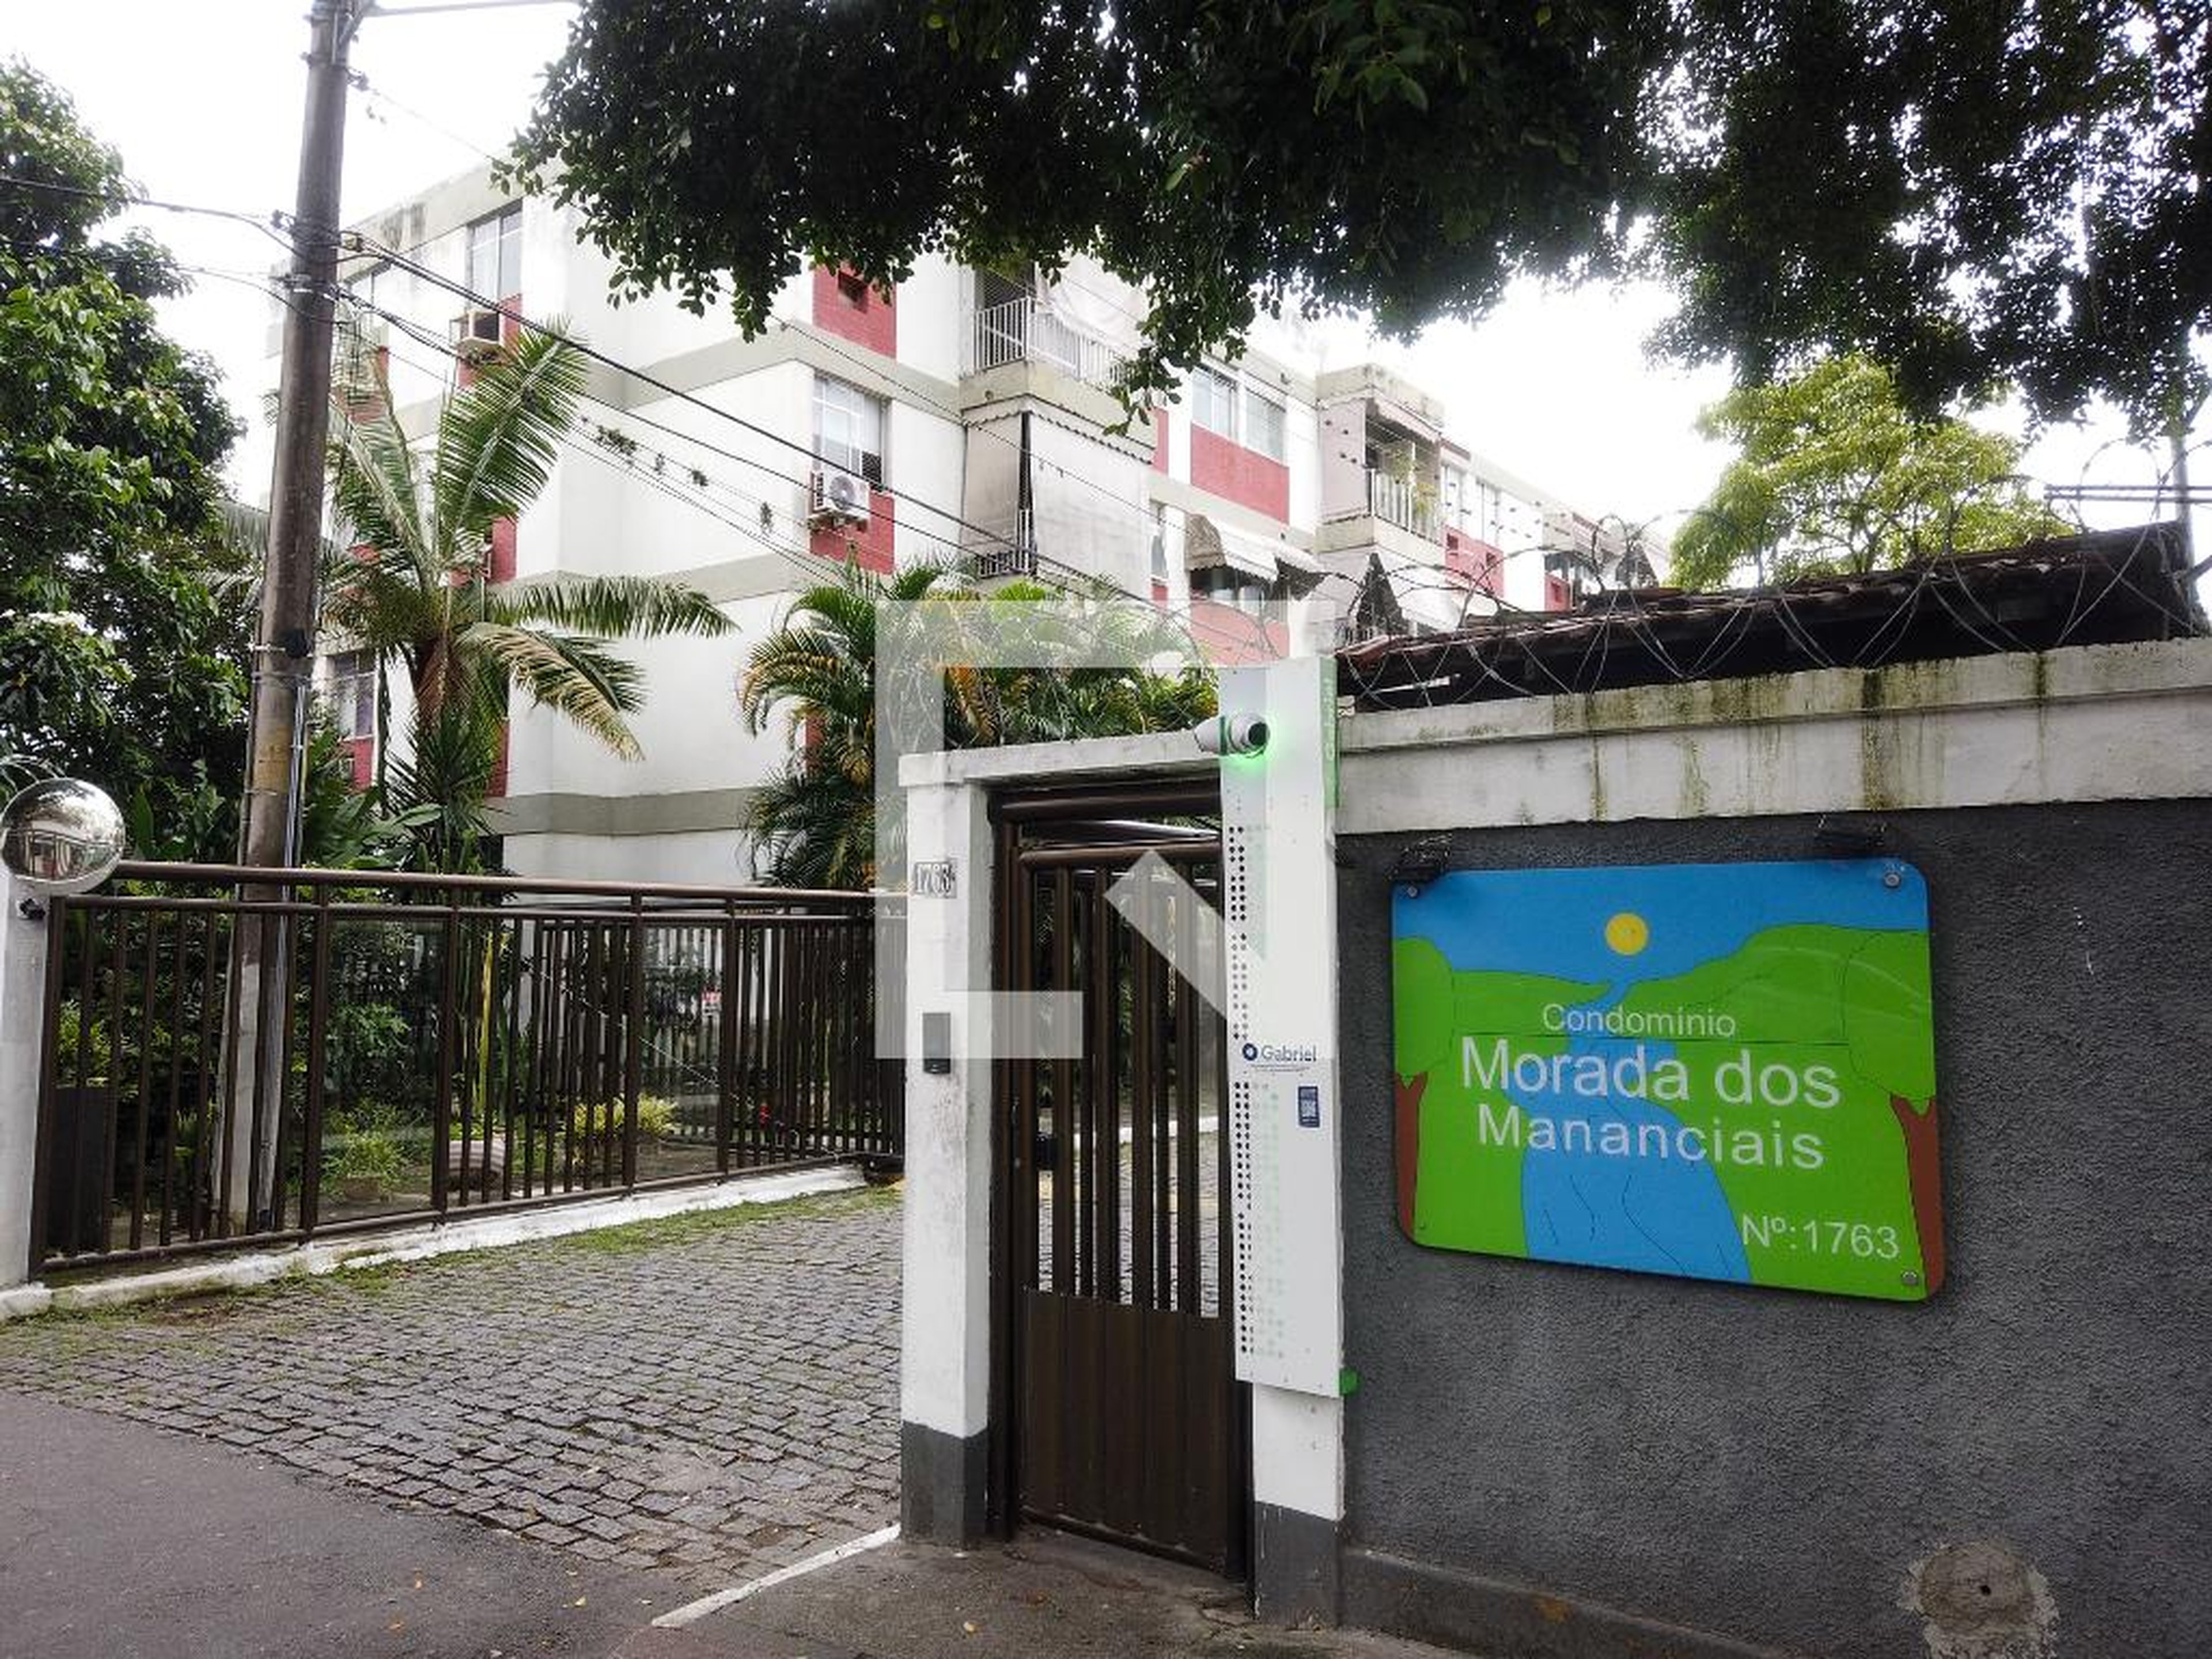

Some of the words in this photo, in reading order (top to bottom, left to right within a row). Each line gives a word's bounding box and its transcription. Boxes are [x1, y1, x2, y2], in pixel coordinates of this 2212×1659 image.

[1261, 1044, 1317, 1061] Gabriel
[1461, 1036, 1690, 1100] Morada
[1714, 1048, 1840, 1109] dos
[1478, 1103, 1825, 1169] Mananciais
